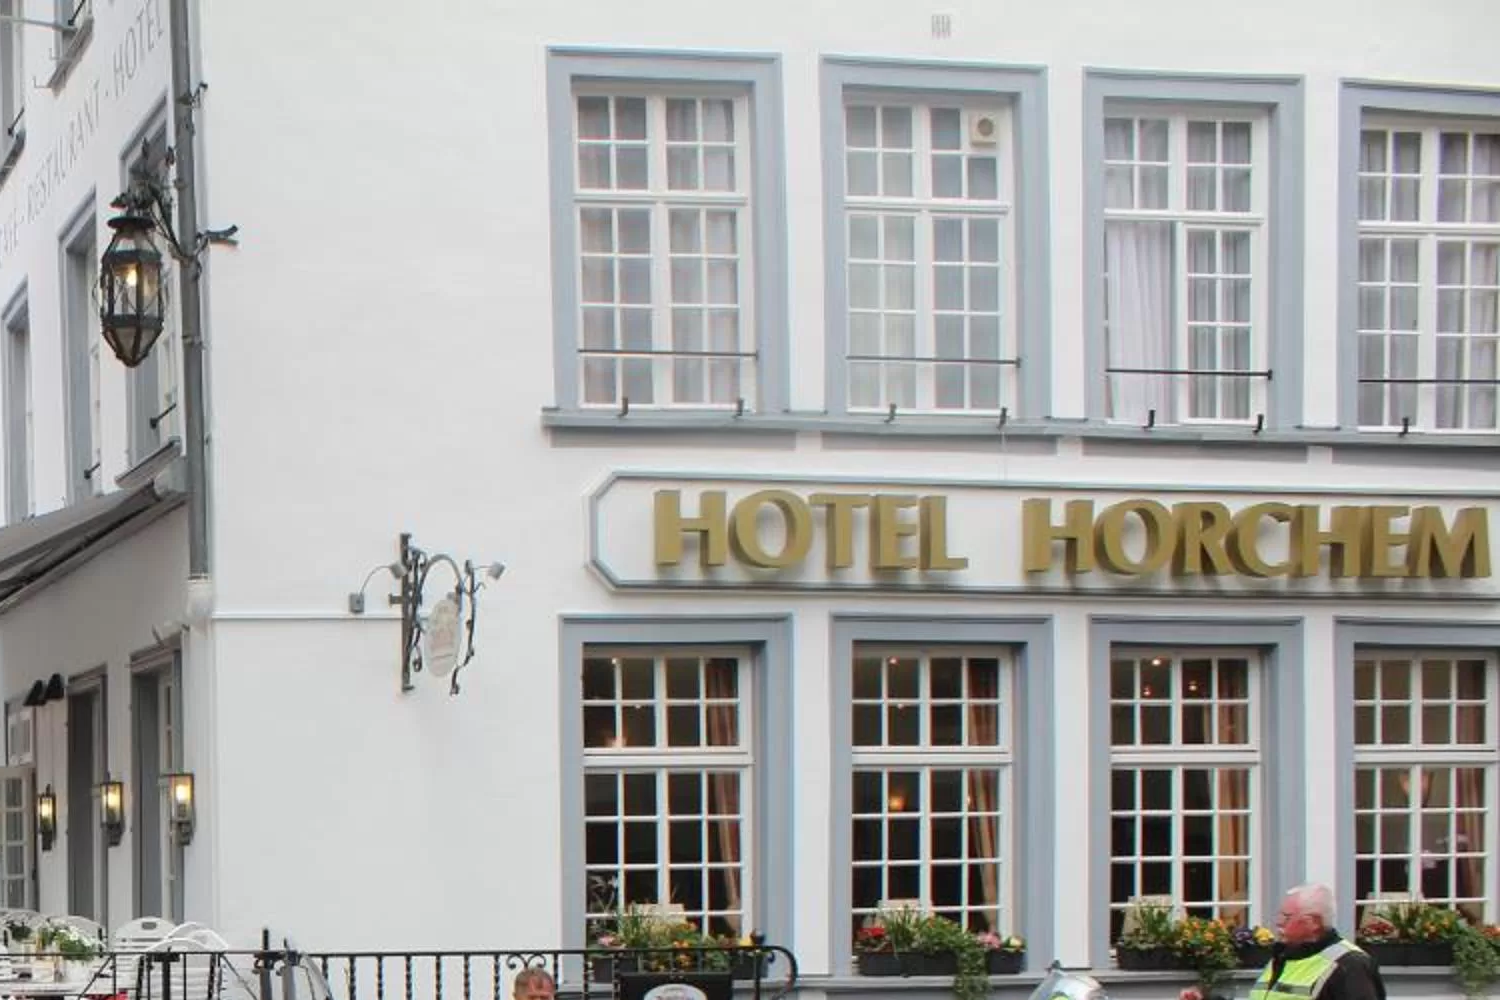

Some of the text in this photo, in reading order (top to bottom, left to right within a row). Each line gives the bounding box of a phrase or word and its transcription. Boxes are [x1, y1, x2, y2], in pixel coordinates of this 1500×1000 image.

[112, 0, 164, 100] HOTEL
[652, 488, 1493, 580] HOTEL HORCHEM
